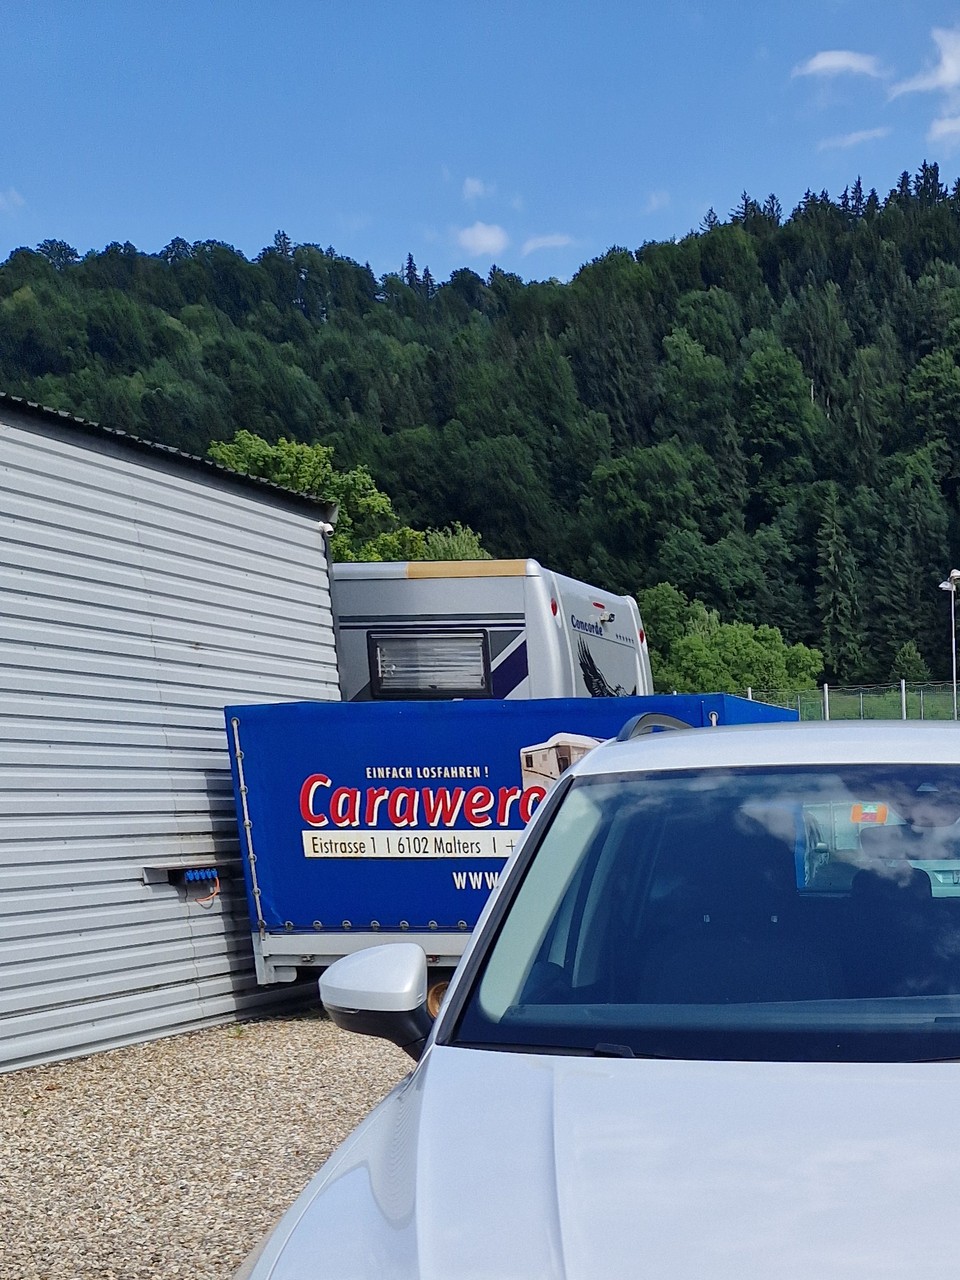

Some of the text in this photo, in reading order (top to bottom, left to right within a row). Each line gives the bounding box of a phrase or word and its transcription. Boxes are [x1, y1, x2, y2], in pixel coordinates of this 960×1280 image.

[571, 614, 603, 636] Concorde
[365, 767, 413, 779] EINFACH
[416, 766, 481, 778] LOSFAHREN
[312, 836, 366, 854] Eistrasse
[370, 837, 376, 854] 1
[398, 837, 430, 854] 6102
[434, 836, 481, 854] Malters
